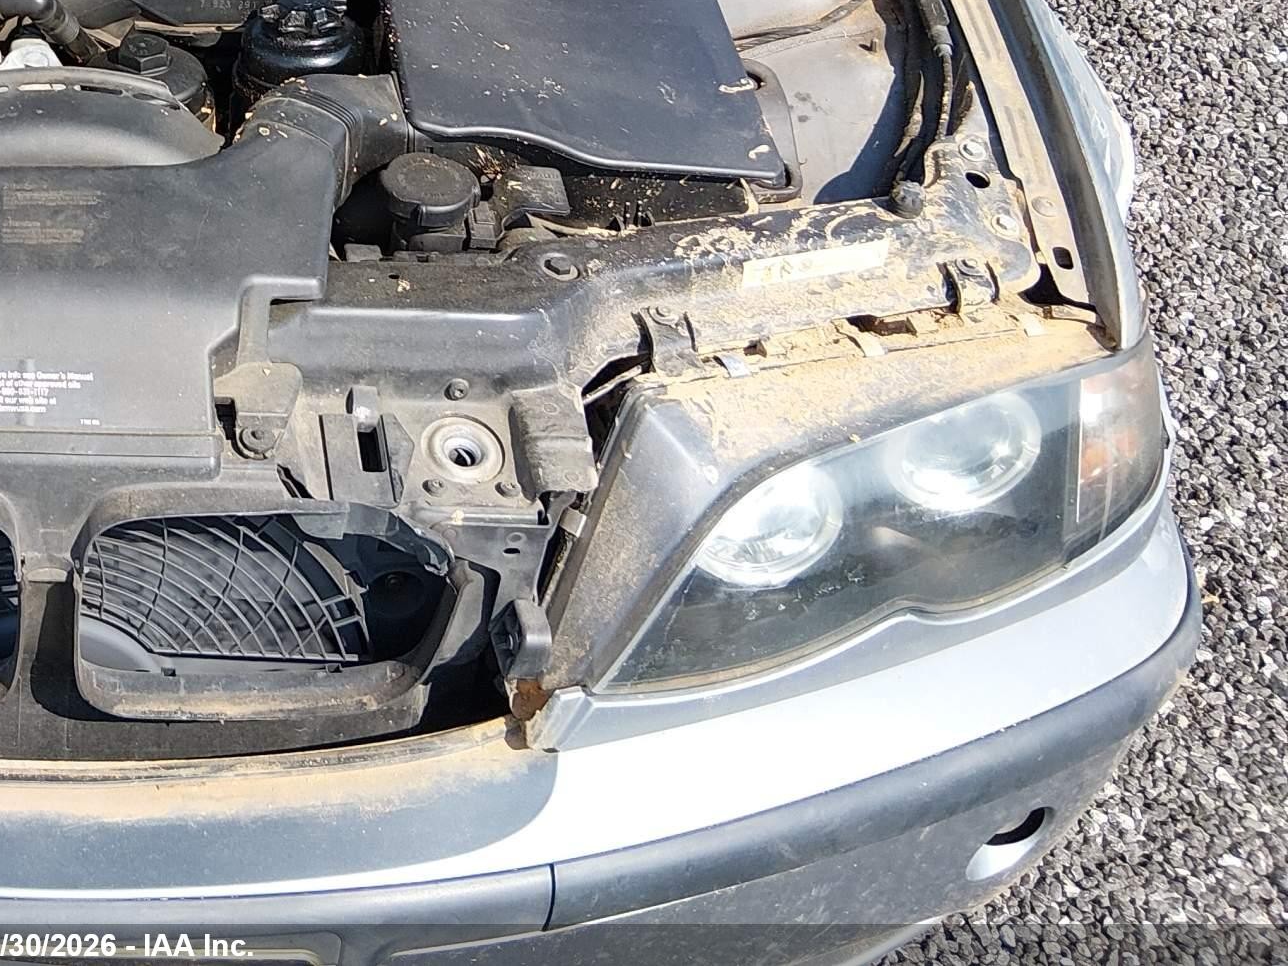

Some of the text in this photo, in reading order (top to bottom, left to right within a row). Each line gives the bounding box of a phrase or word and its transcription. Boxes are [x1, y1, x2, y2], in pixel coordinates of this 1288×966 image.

[36, 371, 65, 380] Owner's
[67, 371, 93, 381] Manual
[6, 379, 13, 387] of
